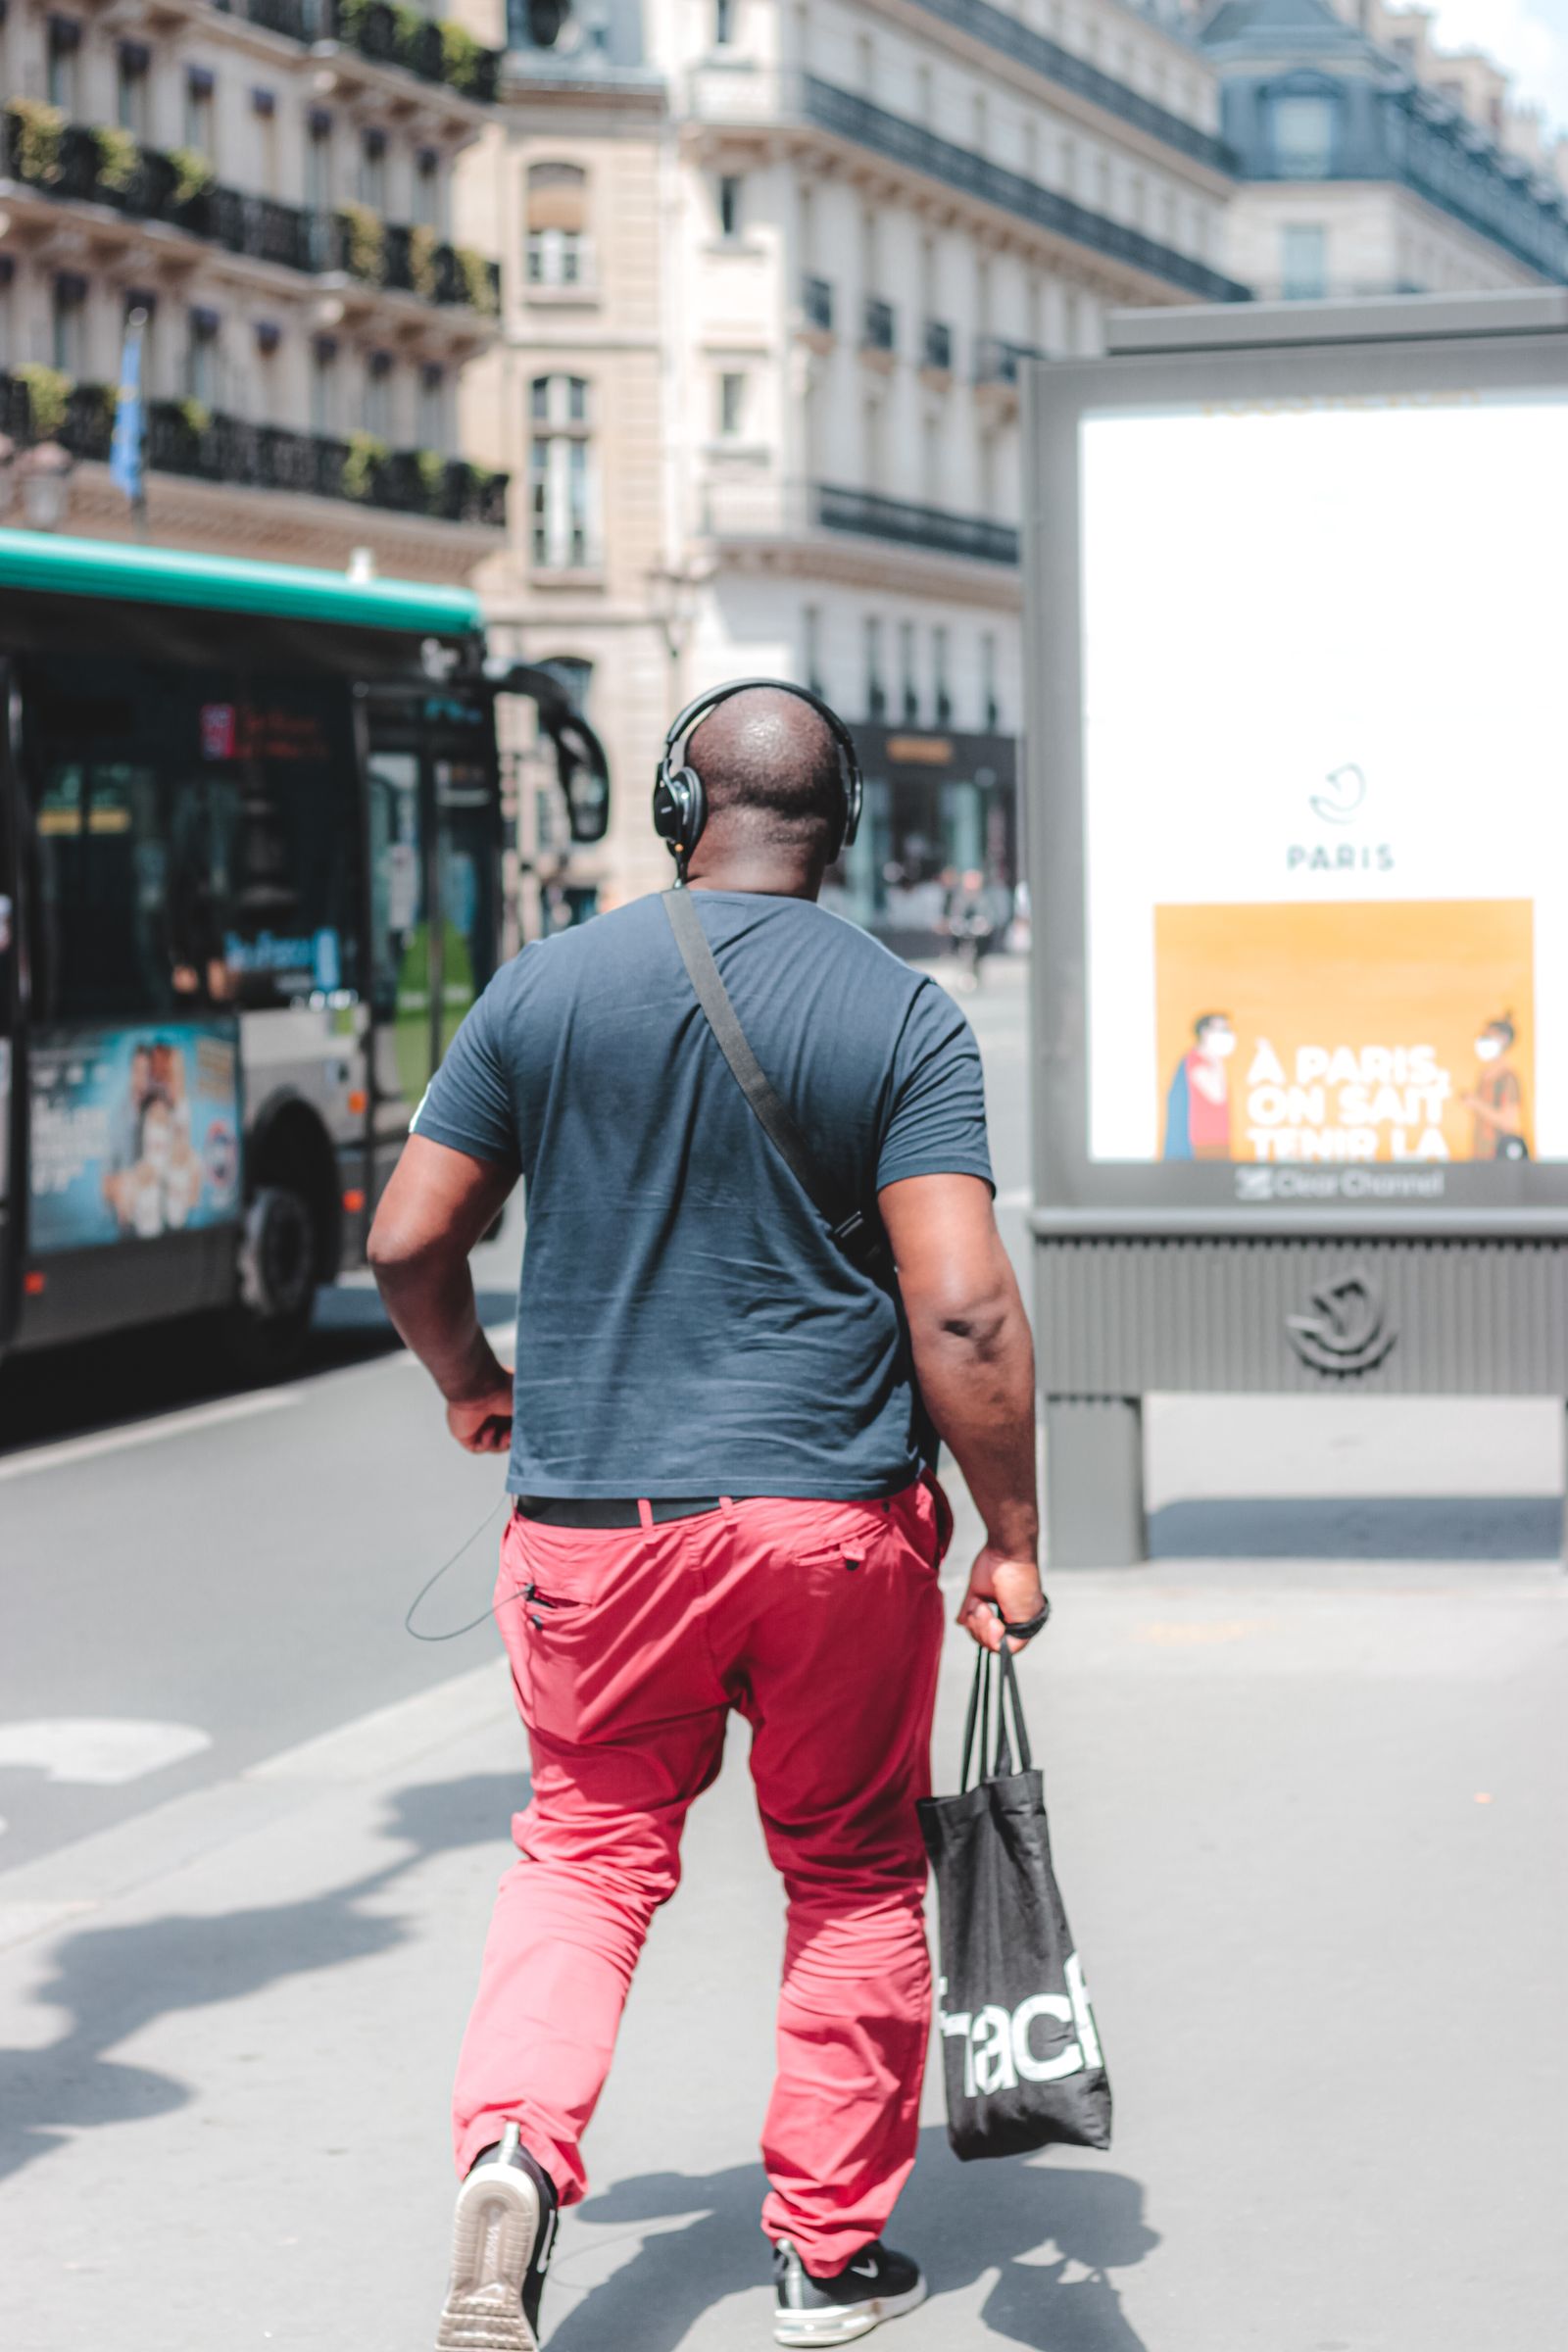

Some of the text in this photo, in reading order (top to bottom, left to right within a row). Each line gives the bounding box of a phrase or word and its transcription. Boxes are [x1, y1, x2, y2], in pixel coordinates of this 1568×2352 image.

[1286, 843, 1395, 871] PARIS
[1246, 1035, 1287, 1086] À
[1247, 1085, 1452, 1126] ON SAIT
[1246, 1127, 1450, 1163] TENIR LA
[1276, 1167, 1446, 1199] Clear Channel
